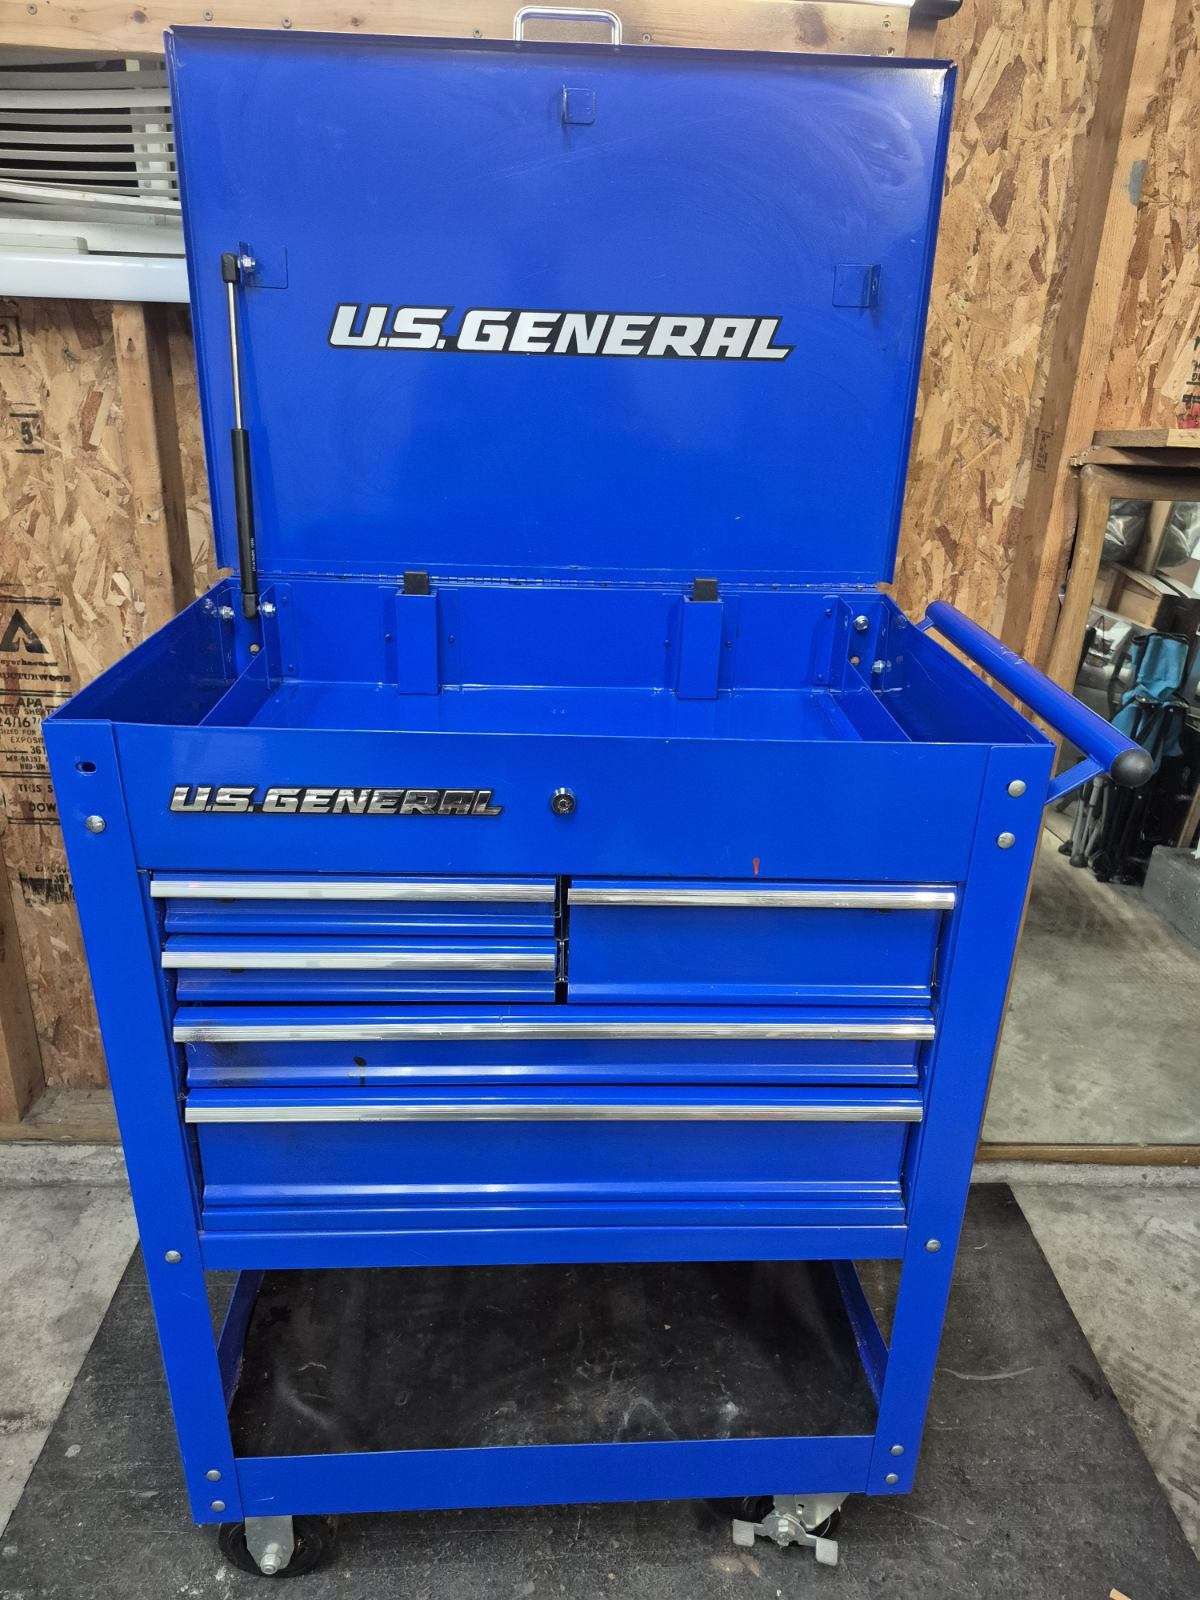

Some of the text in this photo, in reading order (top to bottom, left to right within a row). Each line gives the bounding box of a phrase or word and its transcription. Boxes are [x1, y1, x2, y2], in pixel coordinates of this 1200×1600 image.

[329, 304, 792, 361] U.S. GENERAL
[16, 697, 43, 708] APA
[10, 736, 44, 744] EXPOS
[169, 786, 502, 815] U.S. GENERAL
[28, 802, 57, 812] DOW
